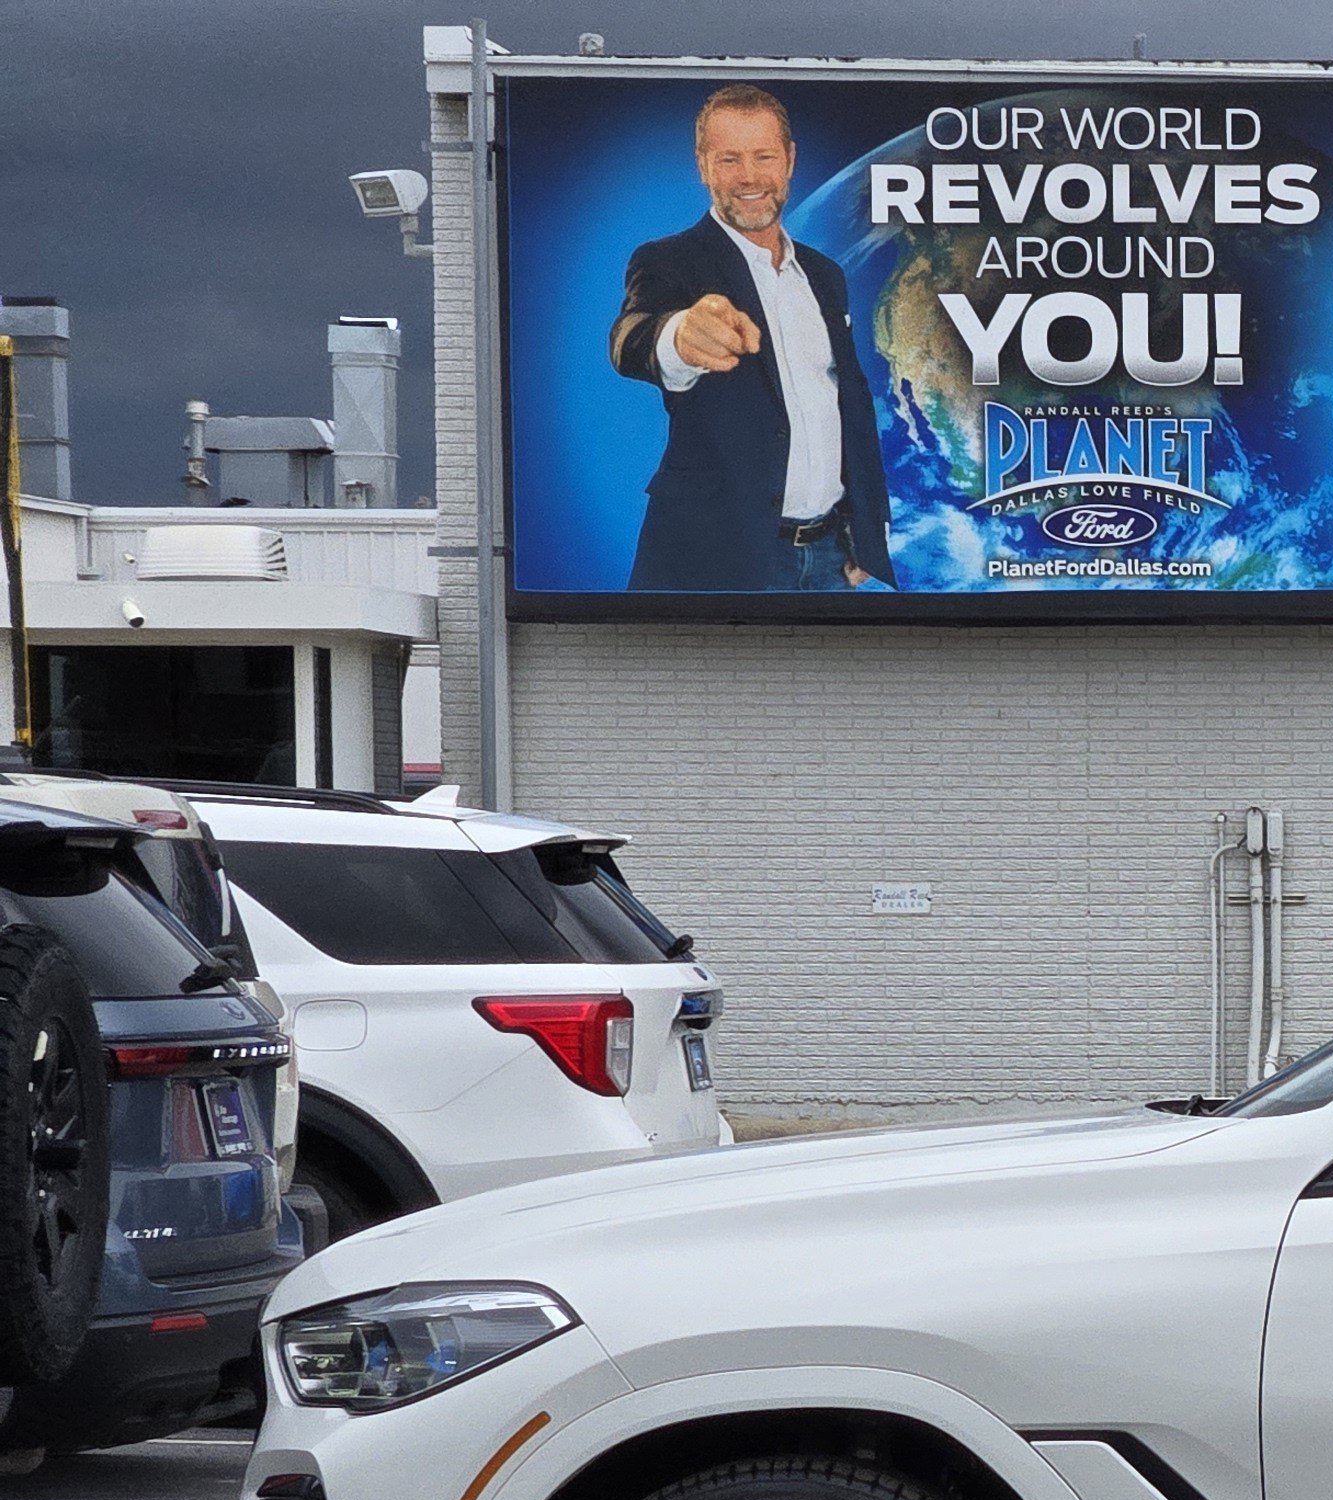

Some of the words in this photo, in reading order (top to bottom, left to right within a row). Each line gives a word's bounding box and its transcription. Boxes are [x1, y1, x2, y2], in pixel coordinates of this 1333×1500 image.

[926, 107, 1044, 150] OUR
[1060, 107, 1261, 150] WORLD
[870, 163, 1321, 225] REVOLVES
[975, 236, 1215, 280] AROUND
[938, 291, 1244, 387] YOU!
[1024, 406, 1101, 416] RANDALL
[1111, 406, 1172, 416] REED'S
[984, 401, 1212, 499] PLANET
[991, 487, 1069, 516] DALLAS
[1080, 485, 1131, 498] LOVE
[1143, 489, 1201, 514] FIELD
[1064, 509, 1135, 539] Ford
[988, 558, 1211, 578] PlanetFordDallas.com
